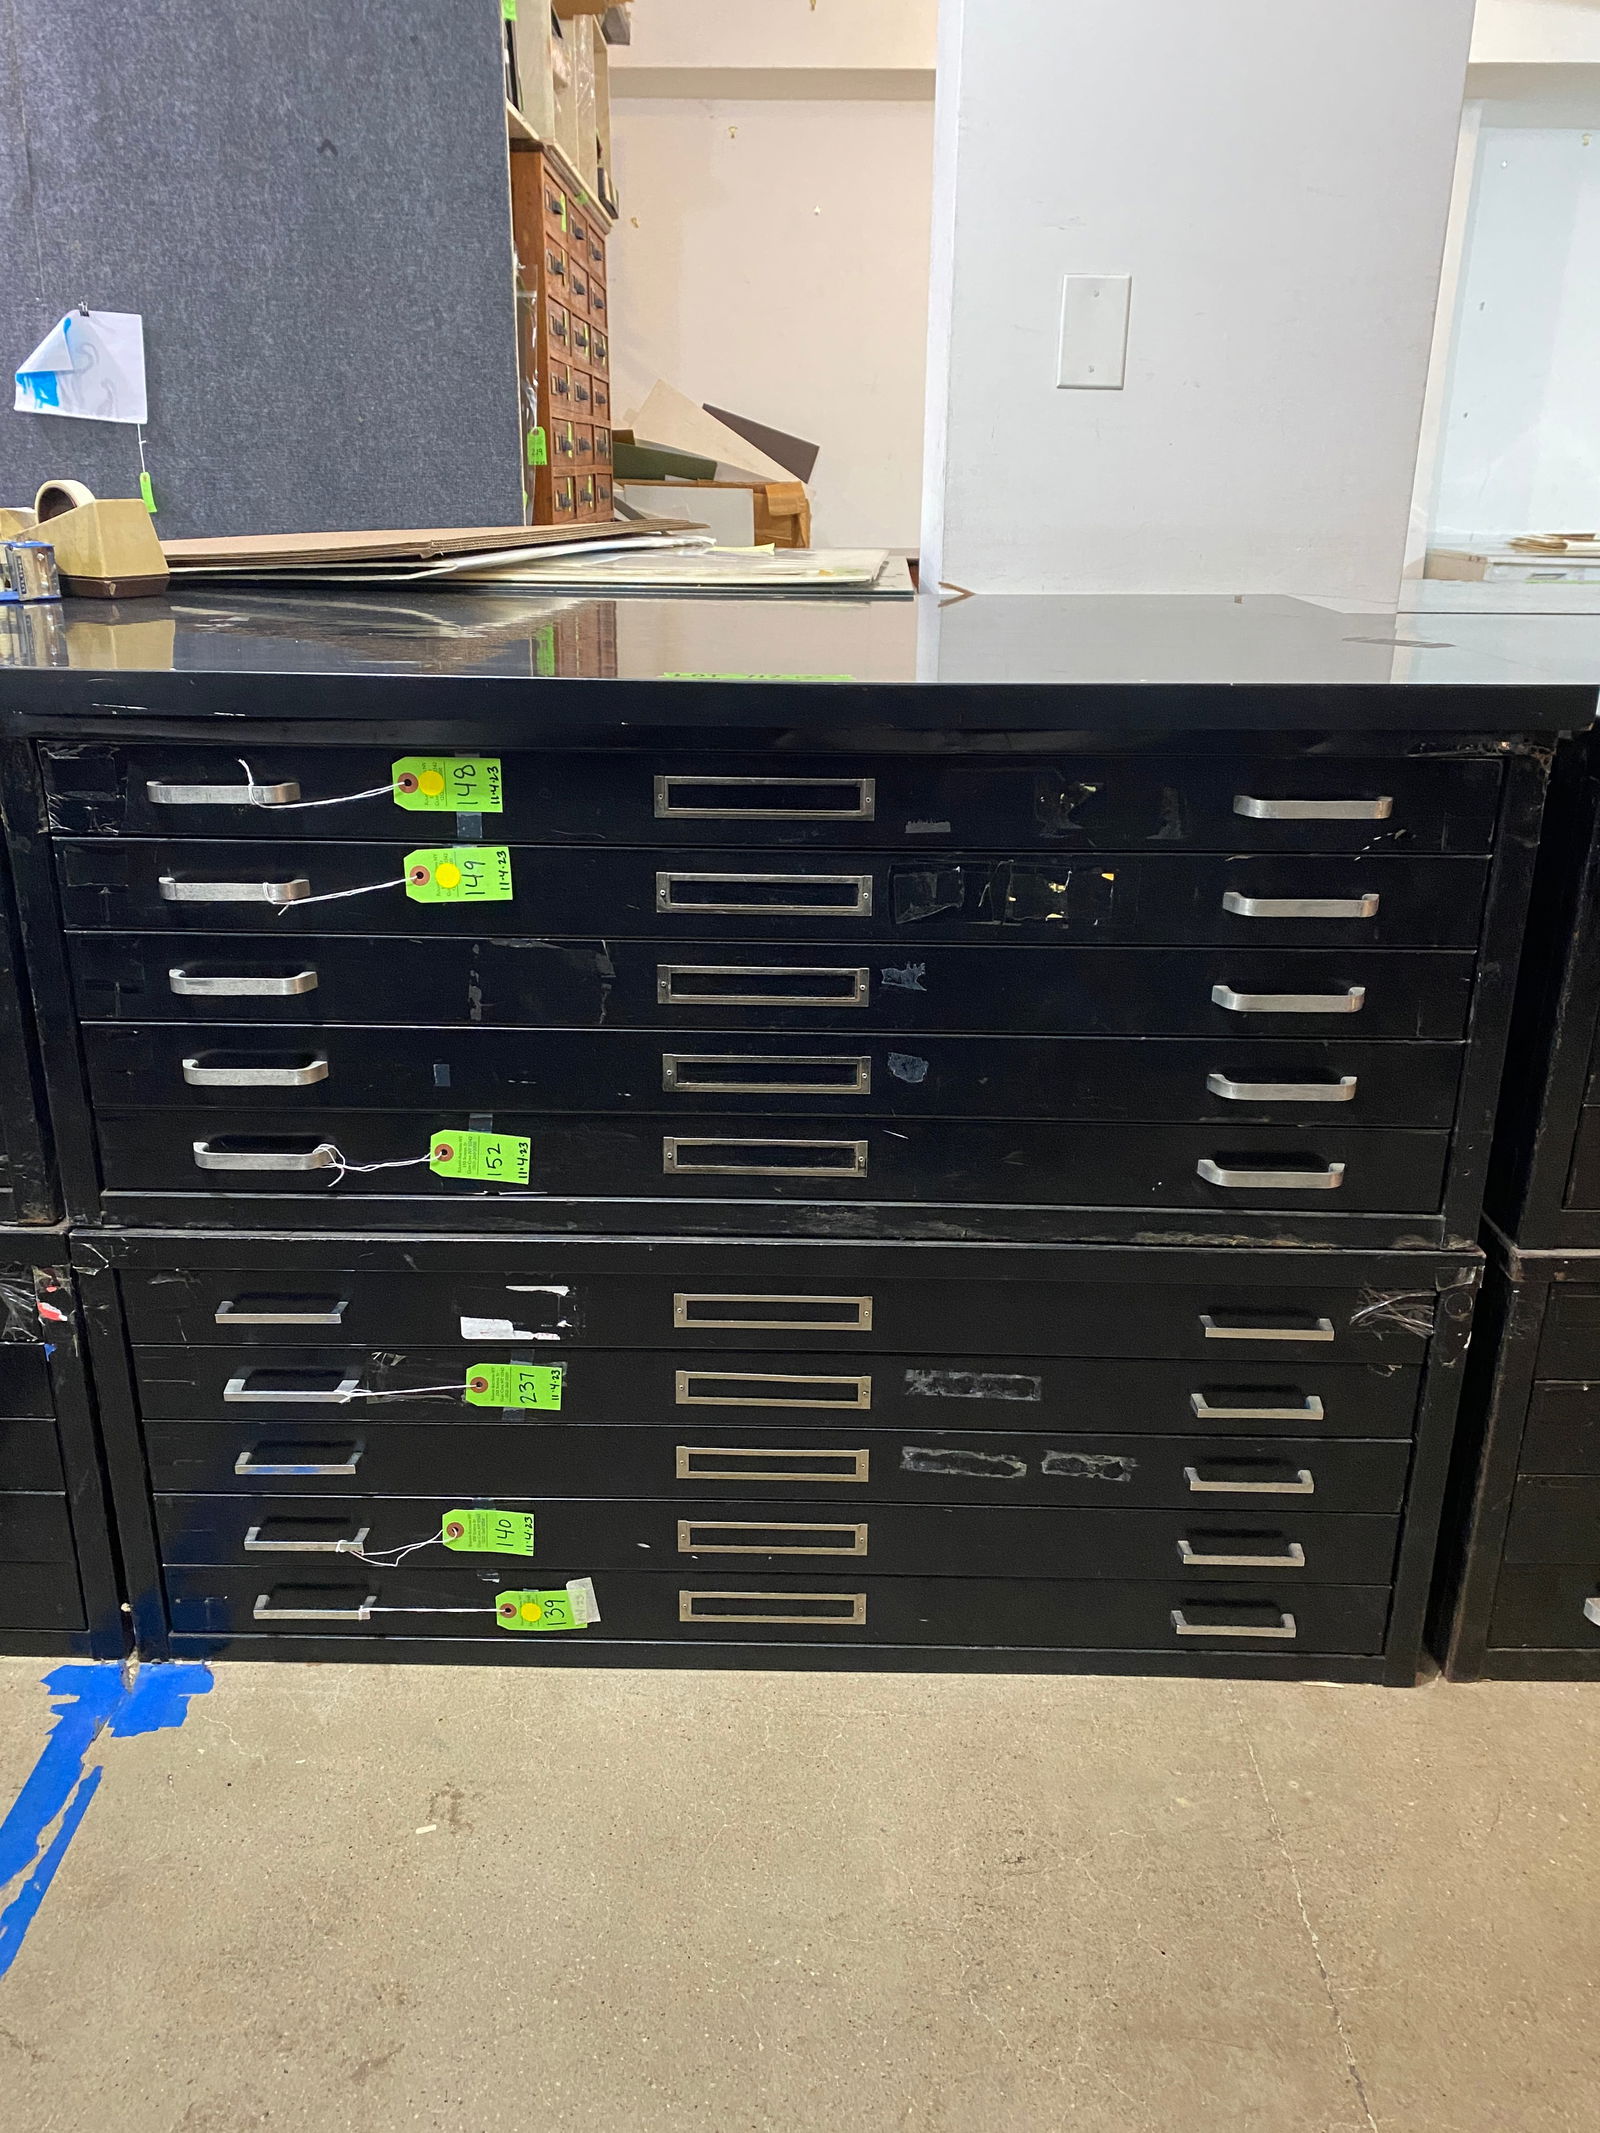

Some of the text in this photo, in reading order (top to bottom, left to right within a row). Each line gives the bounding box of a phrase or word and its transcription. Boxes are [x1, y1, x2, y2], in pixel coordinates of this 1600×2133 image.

[453, 764, 478, 805] 148
[461, 860, 485, 895] 149
[486, 1143, 502, 1176] 152
[519, 1373, 537, 1404] 237
[495, 1519, 515, 1547] 140
[544, 1600, 566, 1626] 139
